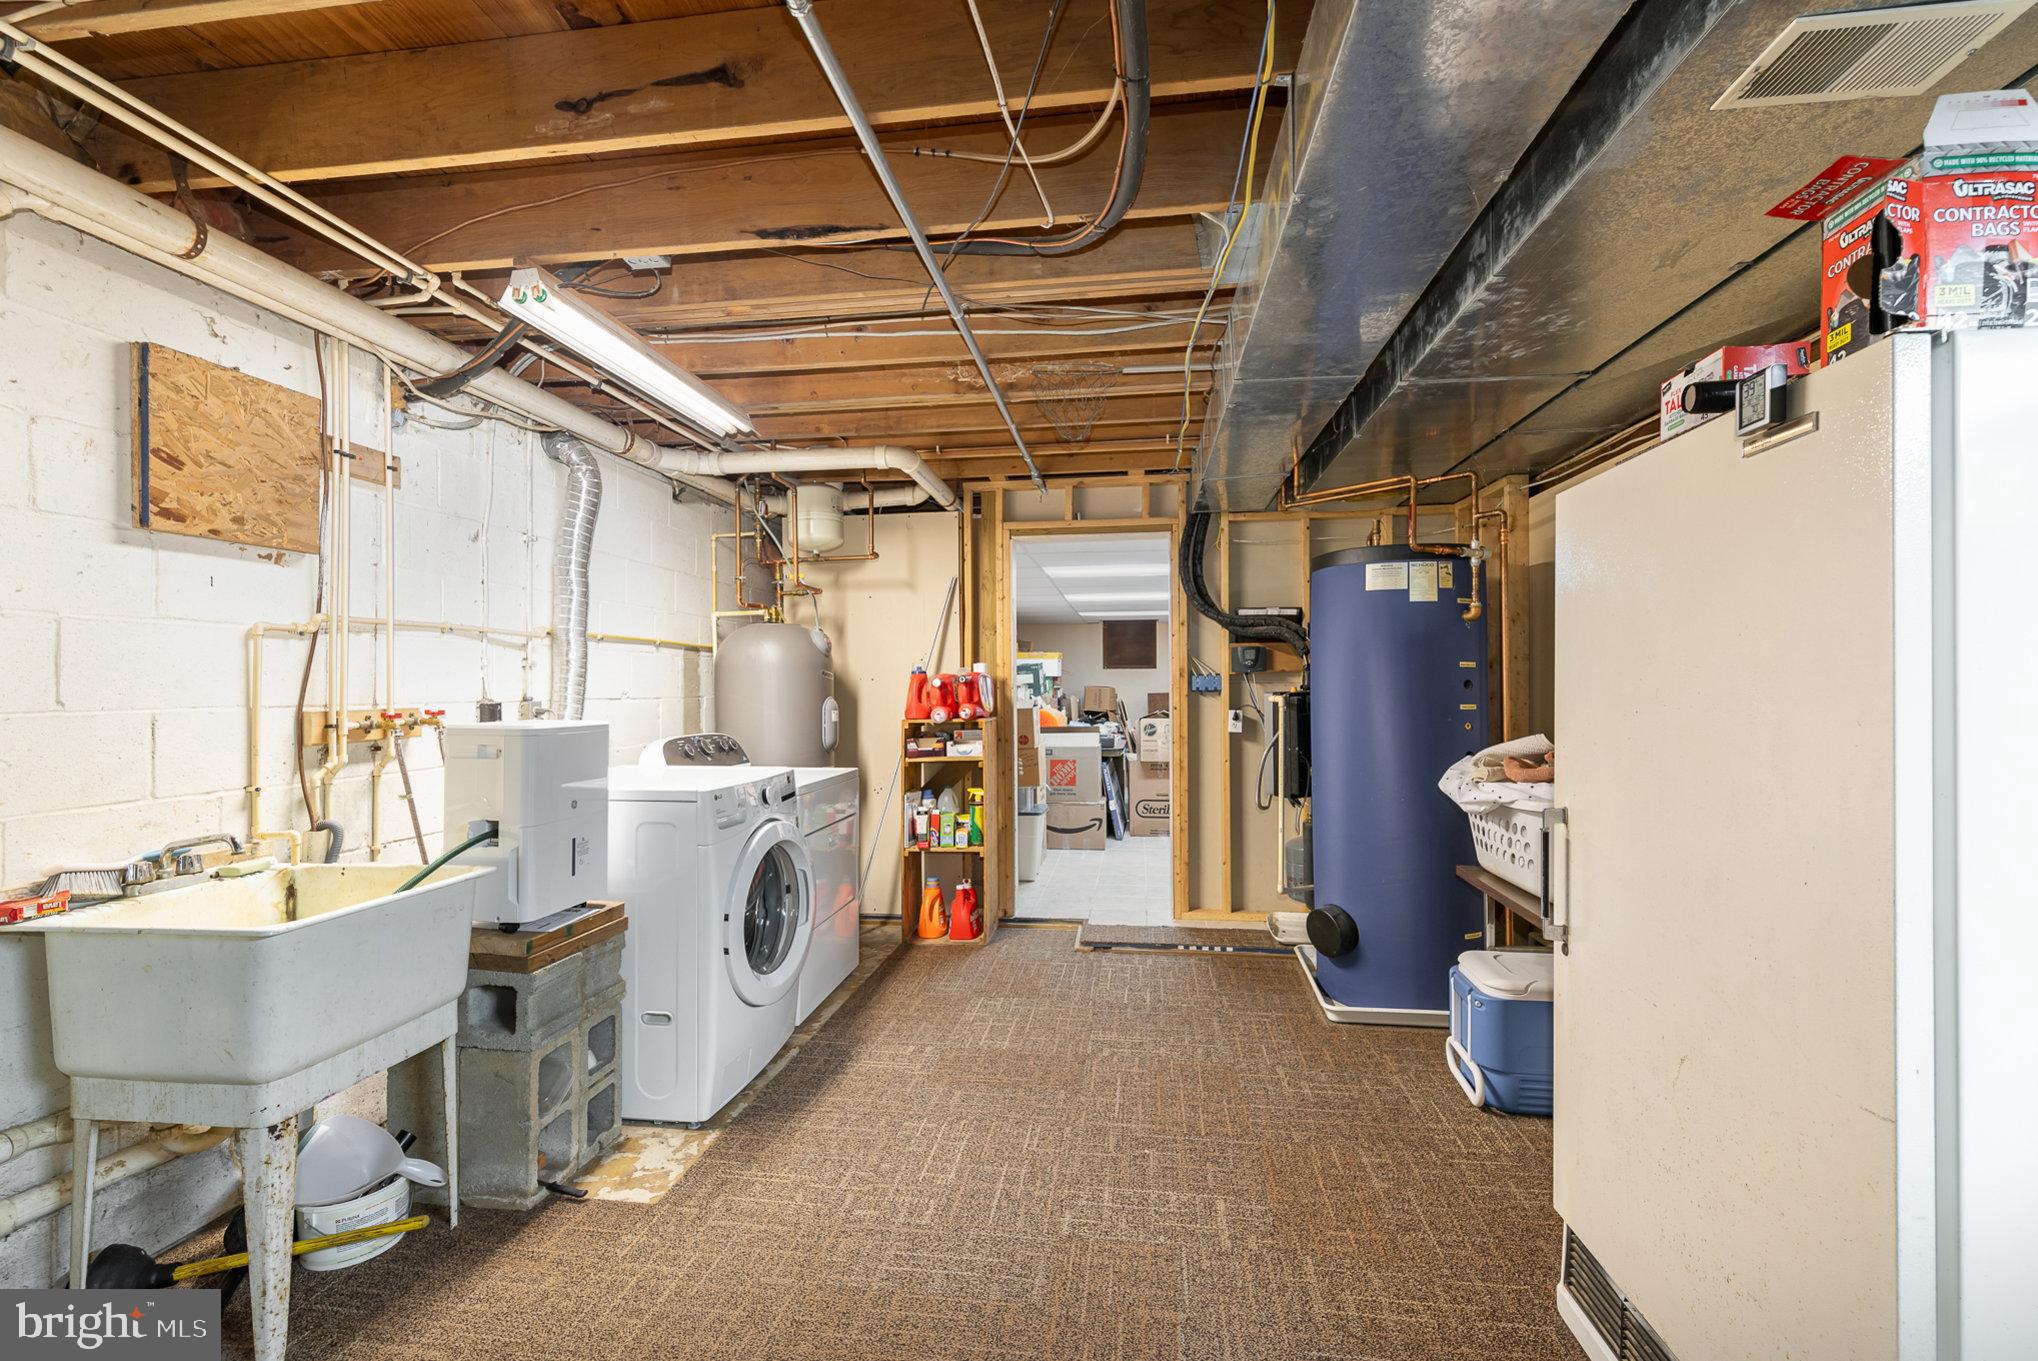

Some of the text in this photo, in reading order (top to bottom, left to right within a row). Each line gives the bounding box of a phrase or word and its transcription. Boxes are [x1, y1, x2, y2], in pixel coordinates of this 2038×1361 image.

[1960, 157, 1976, 165] WITH
[1989, 155, 2015, 163] RECYCLED
[1953, 178, 2036, 197] ULTRASAC
[1840, 218, 1875, 249] ULTRA
[1972, 221, 2021, 237] BAGS
[1939, 285, 1971, 296] 3 MIL
